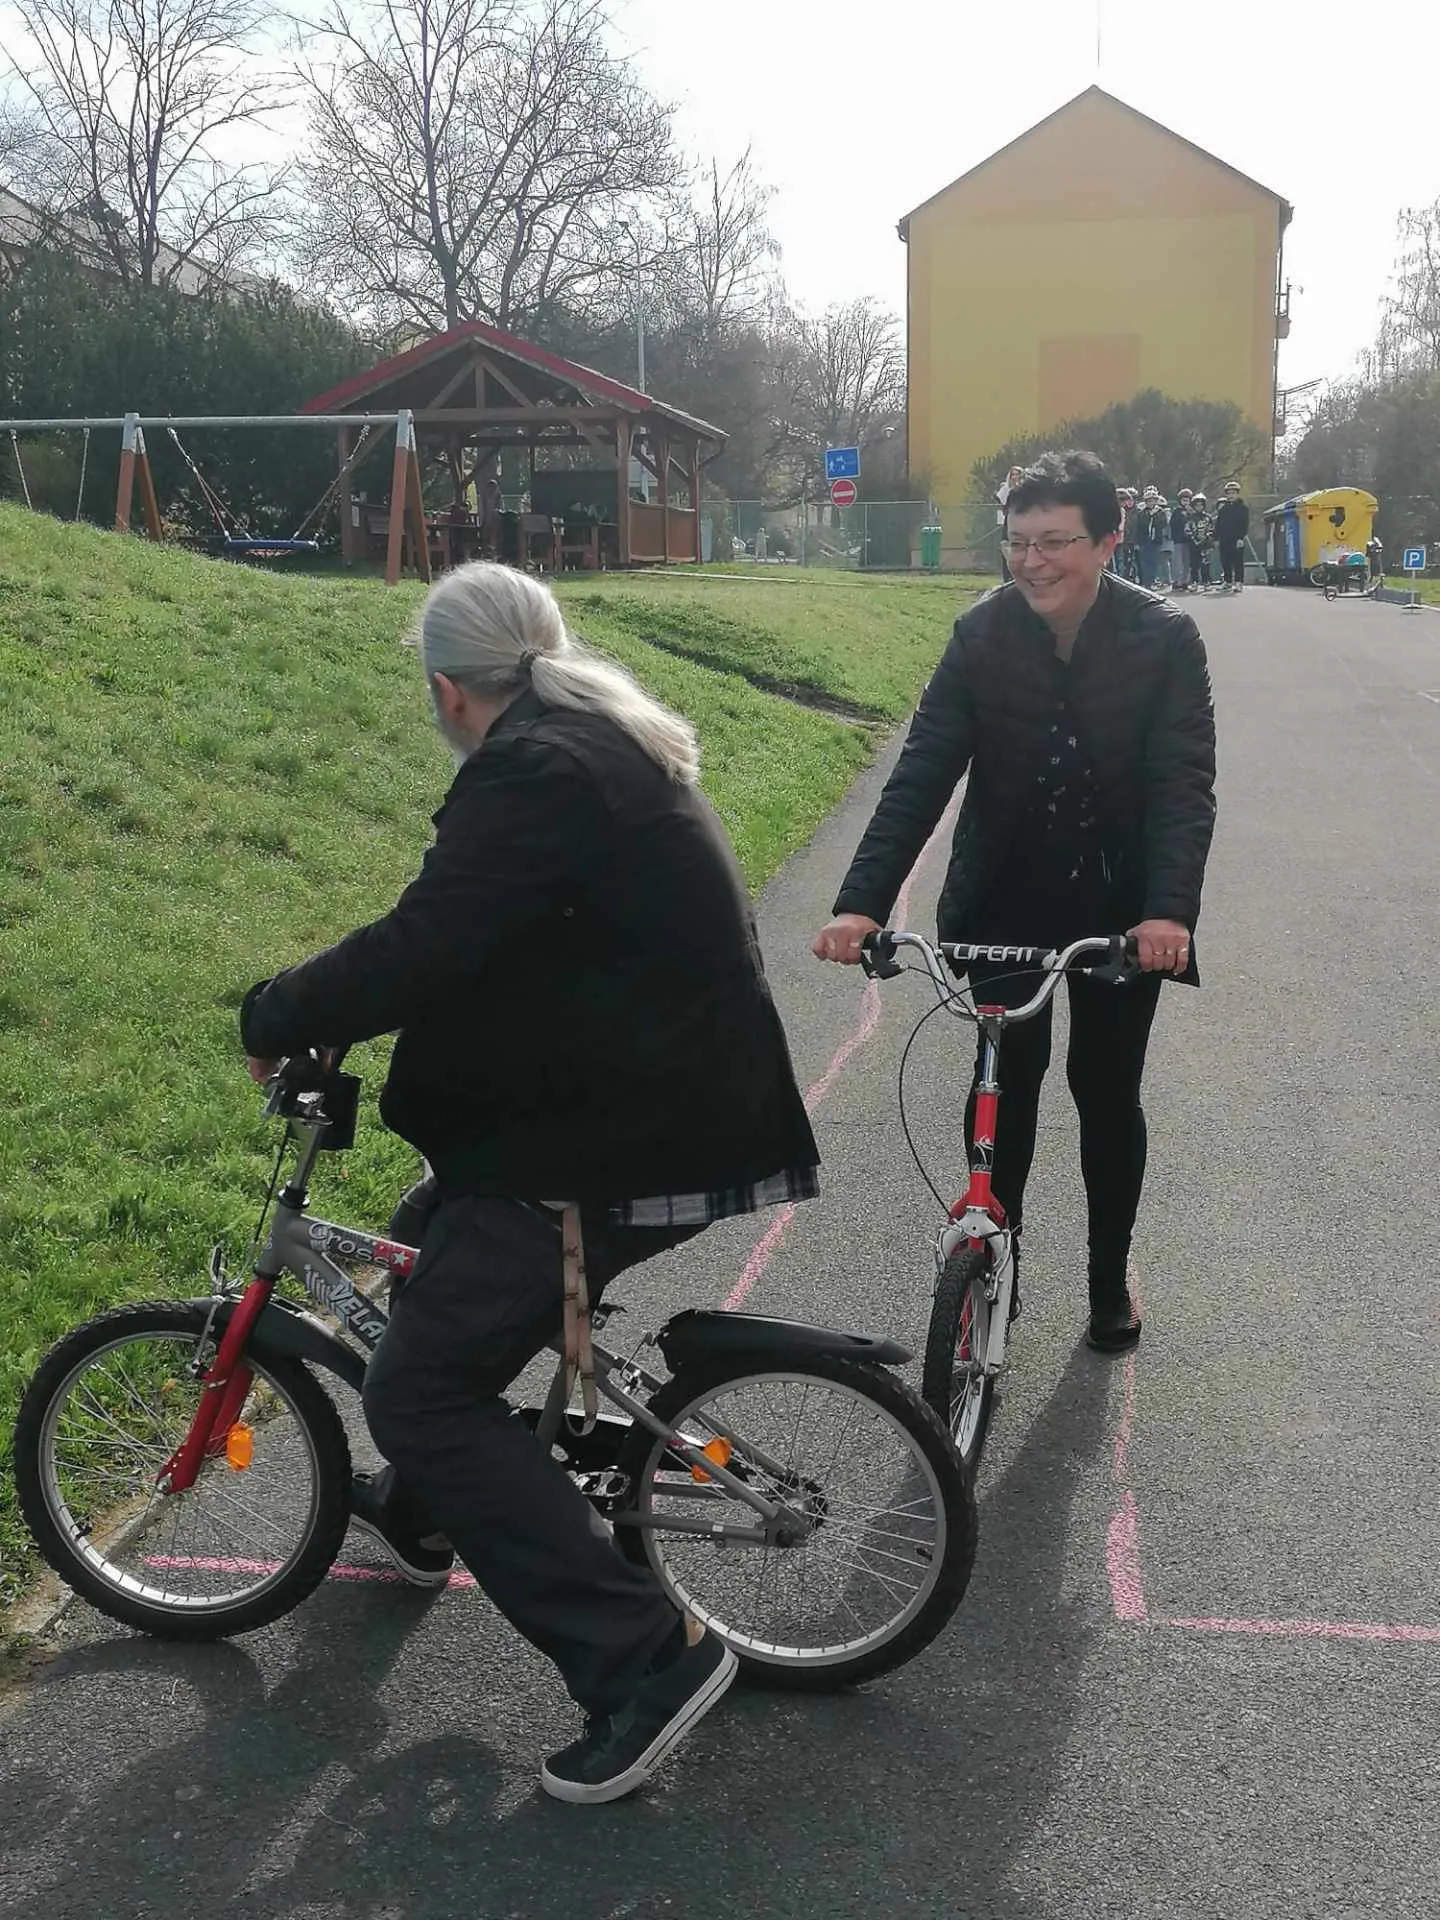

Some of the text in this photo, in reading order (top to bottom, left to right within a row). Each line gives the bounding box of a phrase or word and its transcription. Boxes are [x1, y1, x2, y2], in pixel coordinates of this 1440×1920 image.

[1409, 552, 1420, 564] P
[953, 943, 1039, 963] LIFEFIT
[327, 1281, 388, 1347] VELA
